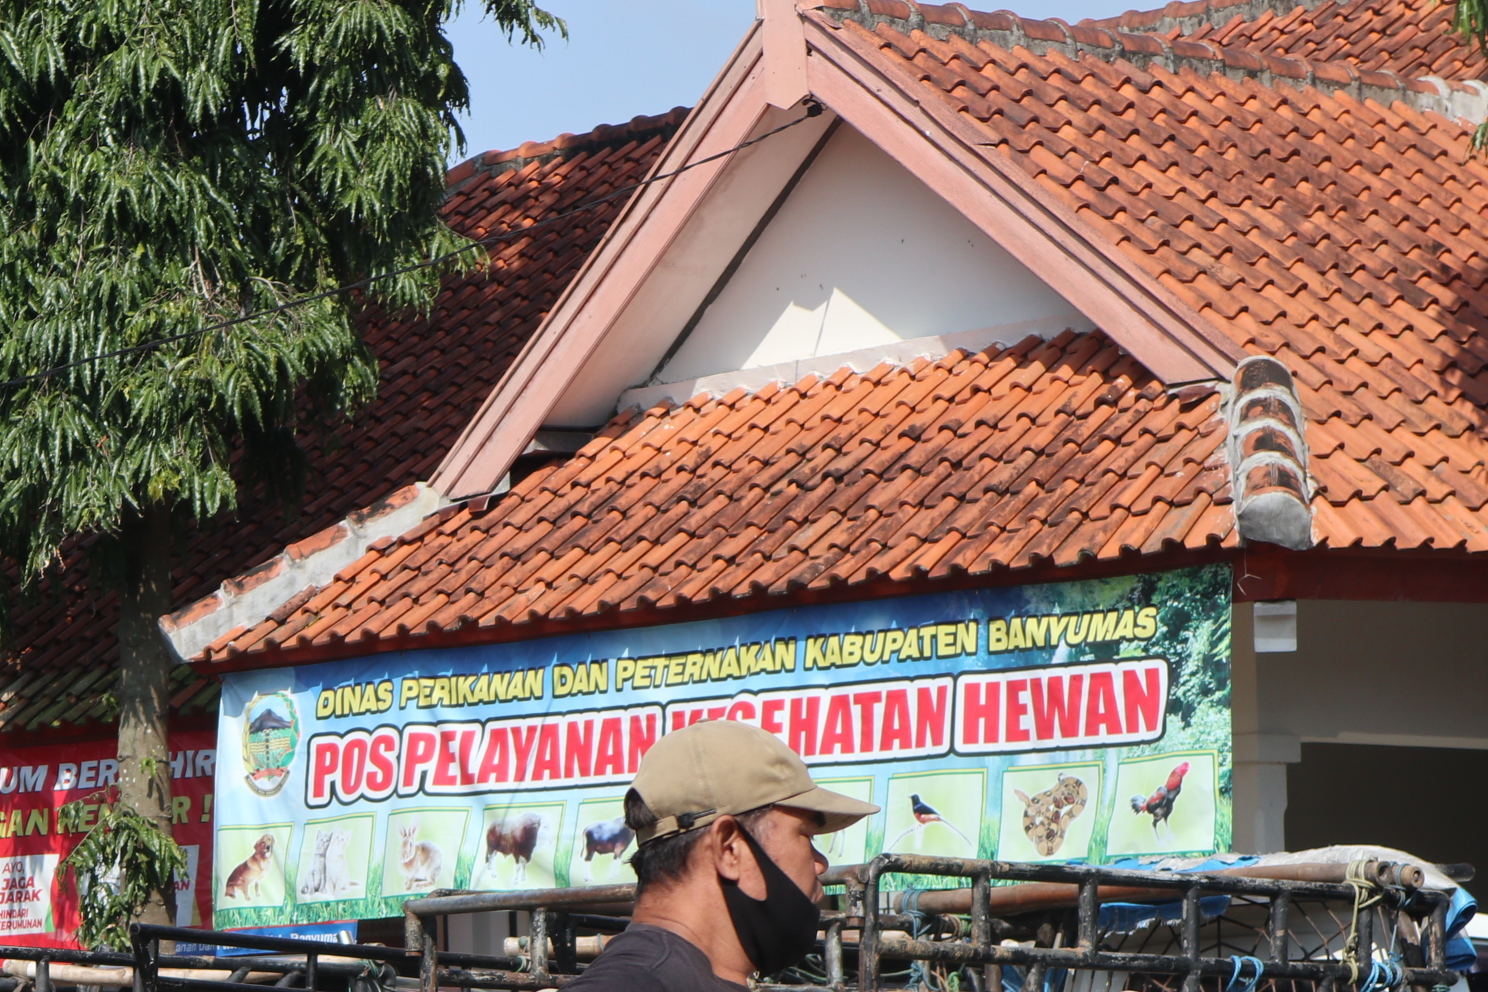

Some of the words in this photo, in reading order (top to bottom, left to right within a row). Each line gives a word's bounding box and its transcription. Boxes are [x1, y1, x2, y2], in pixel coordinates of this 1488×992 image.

[316, 680, 393, 719] DINAS
[399, 667, 544, 709] PERIKANAN
[553, 659, 608, 698] DAN
[615, 637, 796, 691] PETERNAKAN
[803, 619, 977, 671] KABUPATEN
[988, 606, 1158, 653] BANYUMAS
[313, 734, 396, 799] POS
[403, 713, 657, 788] PELAYANAN
[962, 667, 1160, 745] HEWAN
[54, 749, 217, 792] BERHIR
[1, 876, 35, 891] JAGA
[2, 860, 25, 875] AYO,
